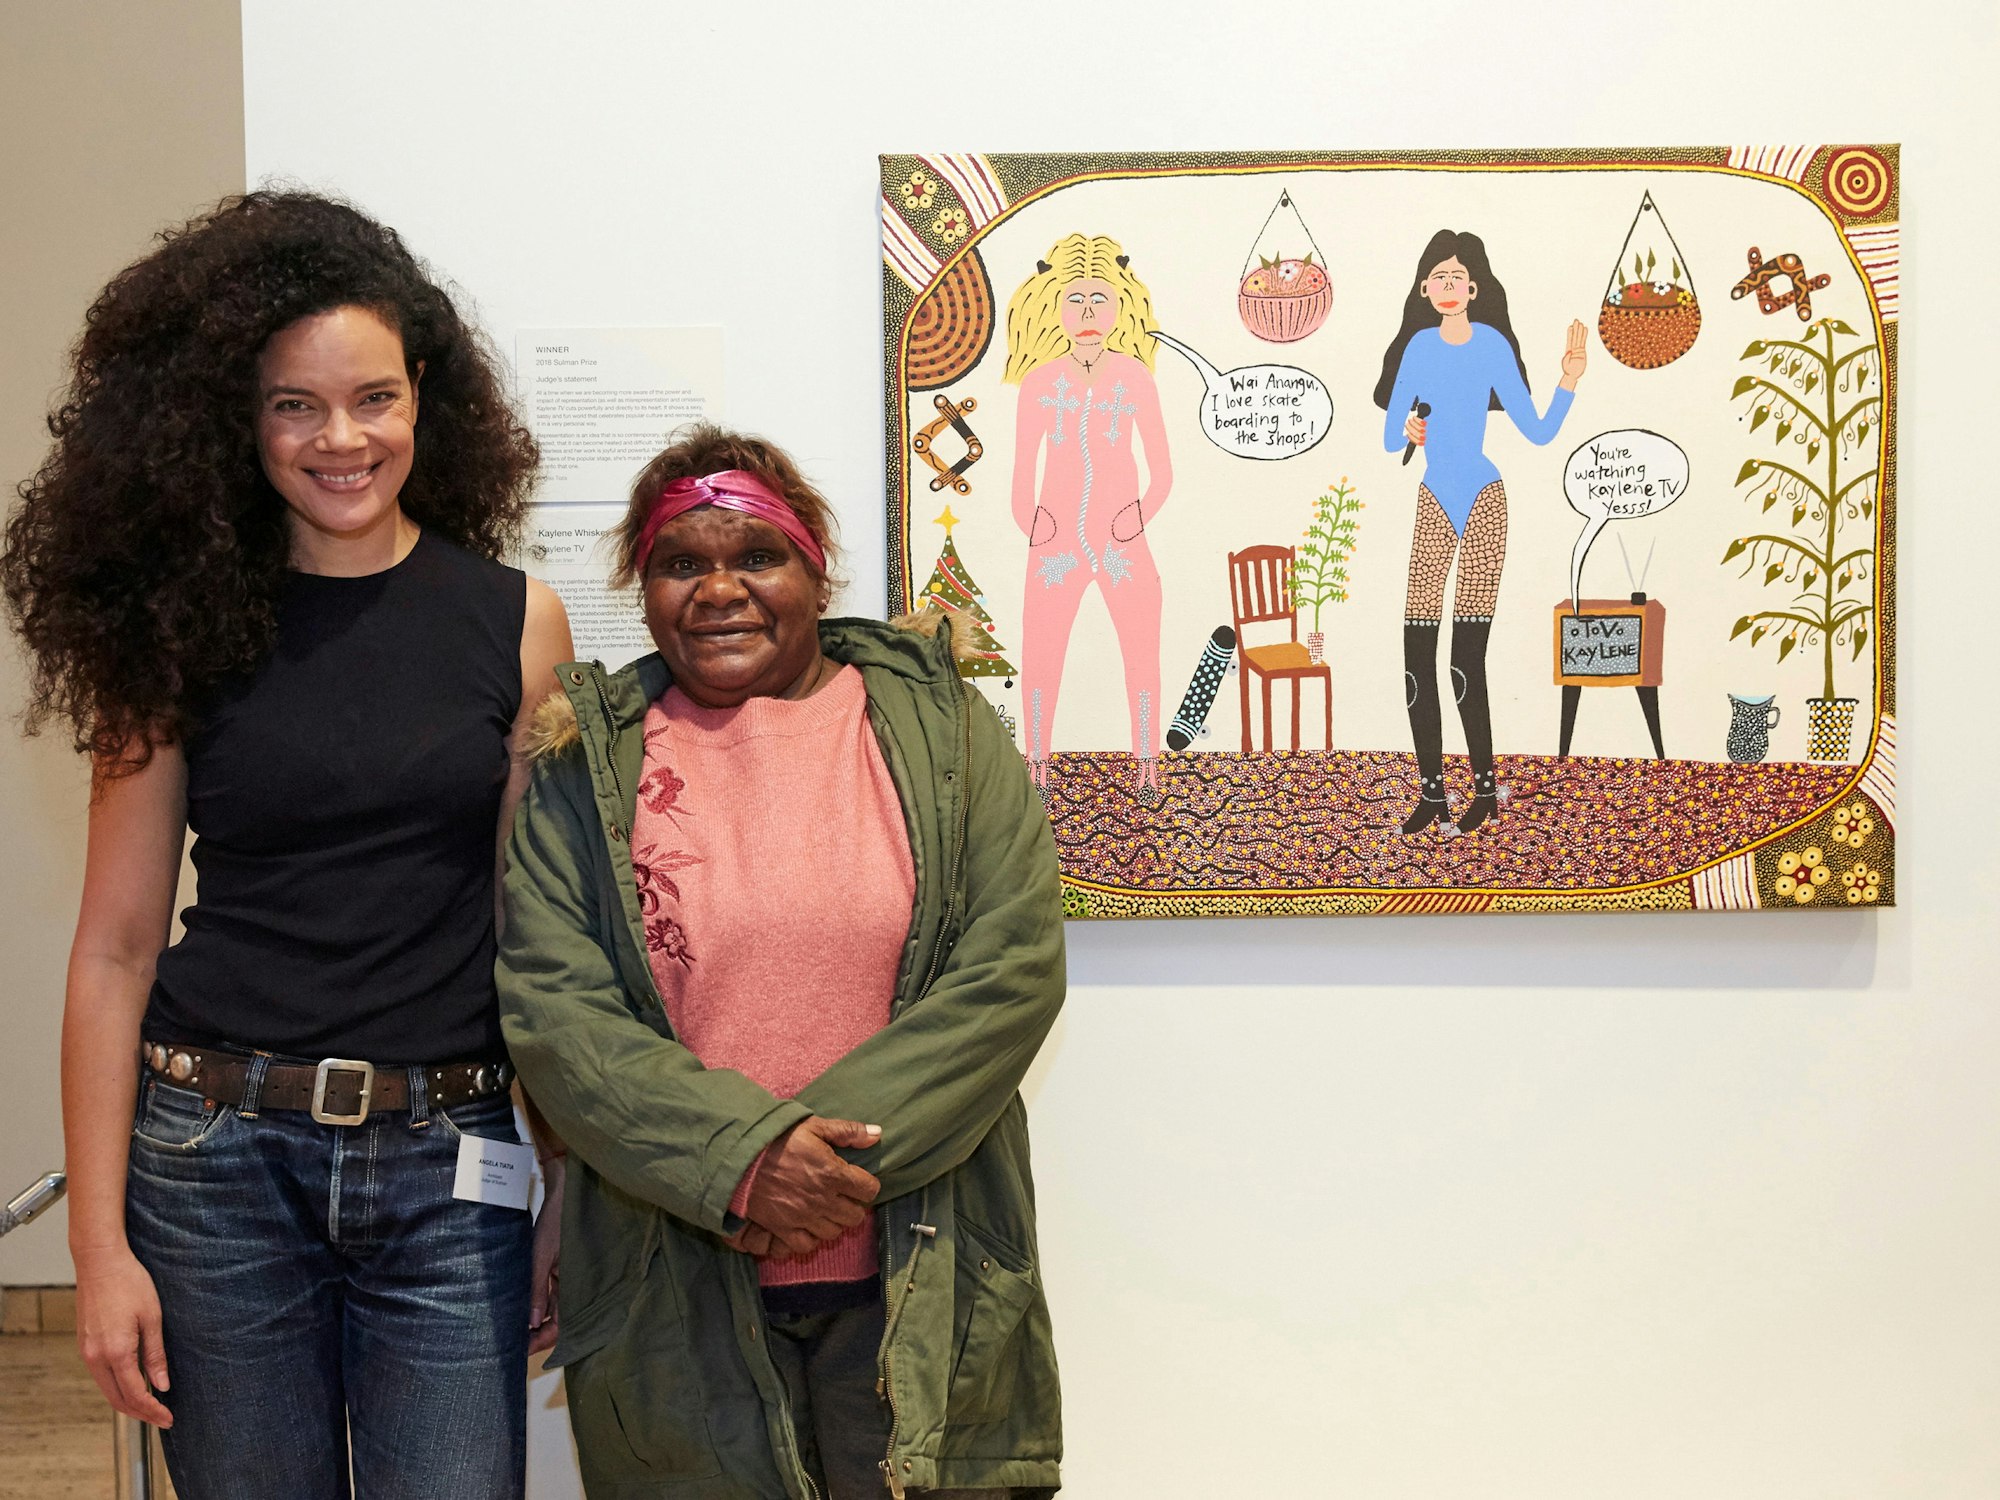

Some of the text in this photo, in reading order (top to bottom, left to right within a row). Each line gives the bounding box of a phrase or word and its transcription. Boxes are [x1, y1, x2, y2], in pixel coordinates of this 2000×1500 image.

[1230, 373, 1318, 396] Wai Anangu,
[1212, 393, 1302, 412] I love skate
[1215, 411, 1302, 434] boarding to
[1235, 430, 1259, 445] the
[1590, 443, 1632, 466] You're
[1574, 464, 1646, 482] watching
[1658, 478, 1680, 498] TV
[1602, 499, 1652, 516] Yesss!
[538, 529, 610, 539] Kaylene Whiskey
[1564, 643, 1636, 666] KAYLENE
[479, 1159, 498, 1168] ANGELA
